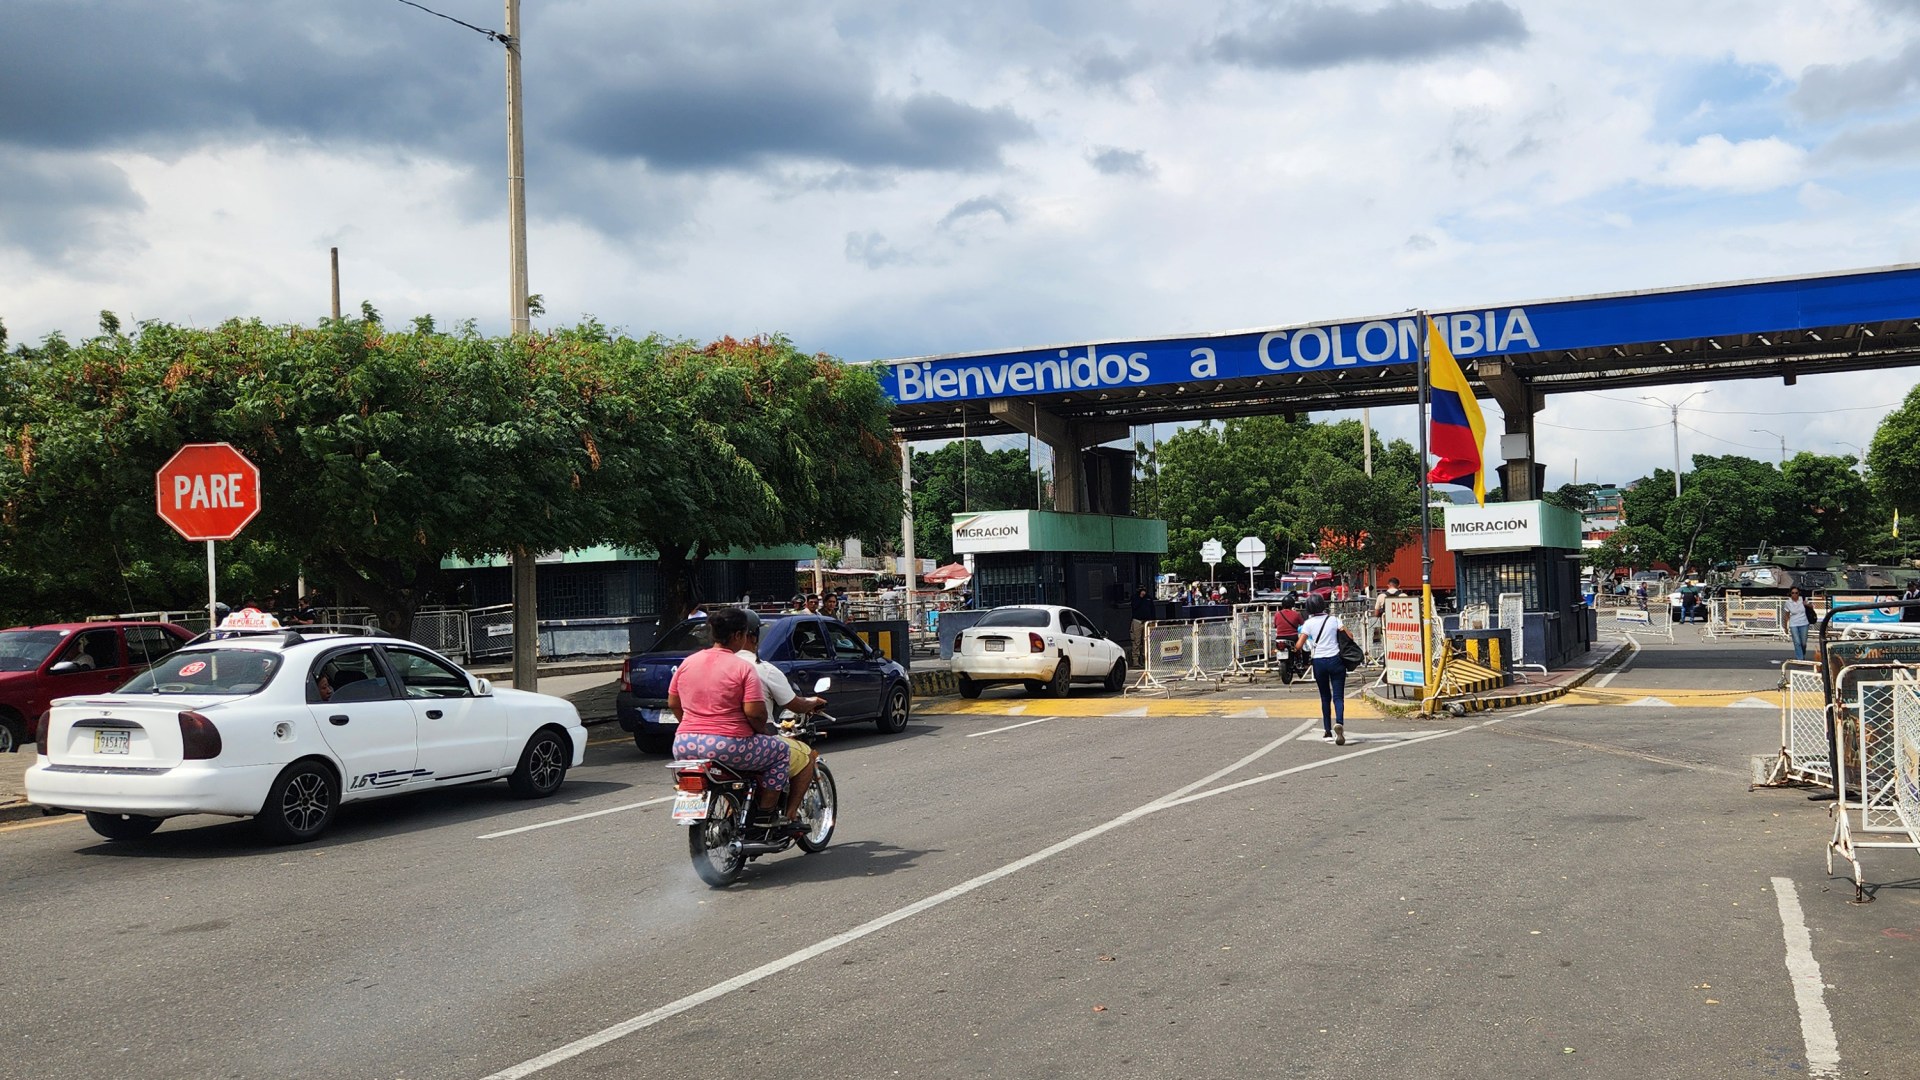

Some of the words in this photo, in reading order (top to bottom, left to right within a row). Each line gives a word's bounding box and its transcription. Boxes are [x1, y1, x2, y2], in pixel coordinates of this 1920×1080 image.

[896, 344, 1150, 401] Bienvenidos
[1189, 346, 1217, 378] a
[1258, 307, 1540, 371] COLOMBIA
[174, 473, 244, 510] PARE
[956, 525, 1019, 538] MIGRACIÓN
[1450, 517, 1528, 533] MIGRACIÓN
[1391, 602, 1413, 619] PARE
